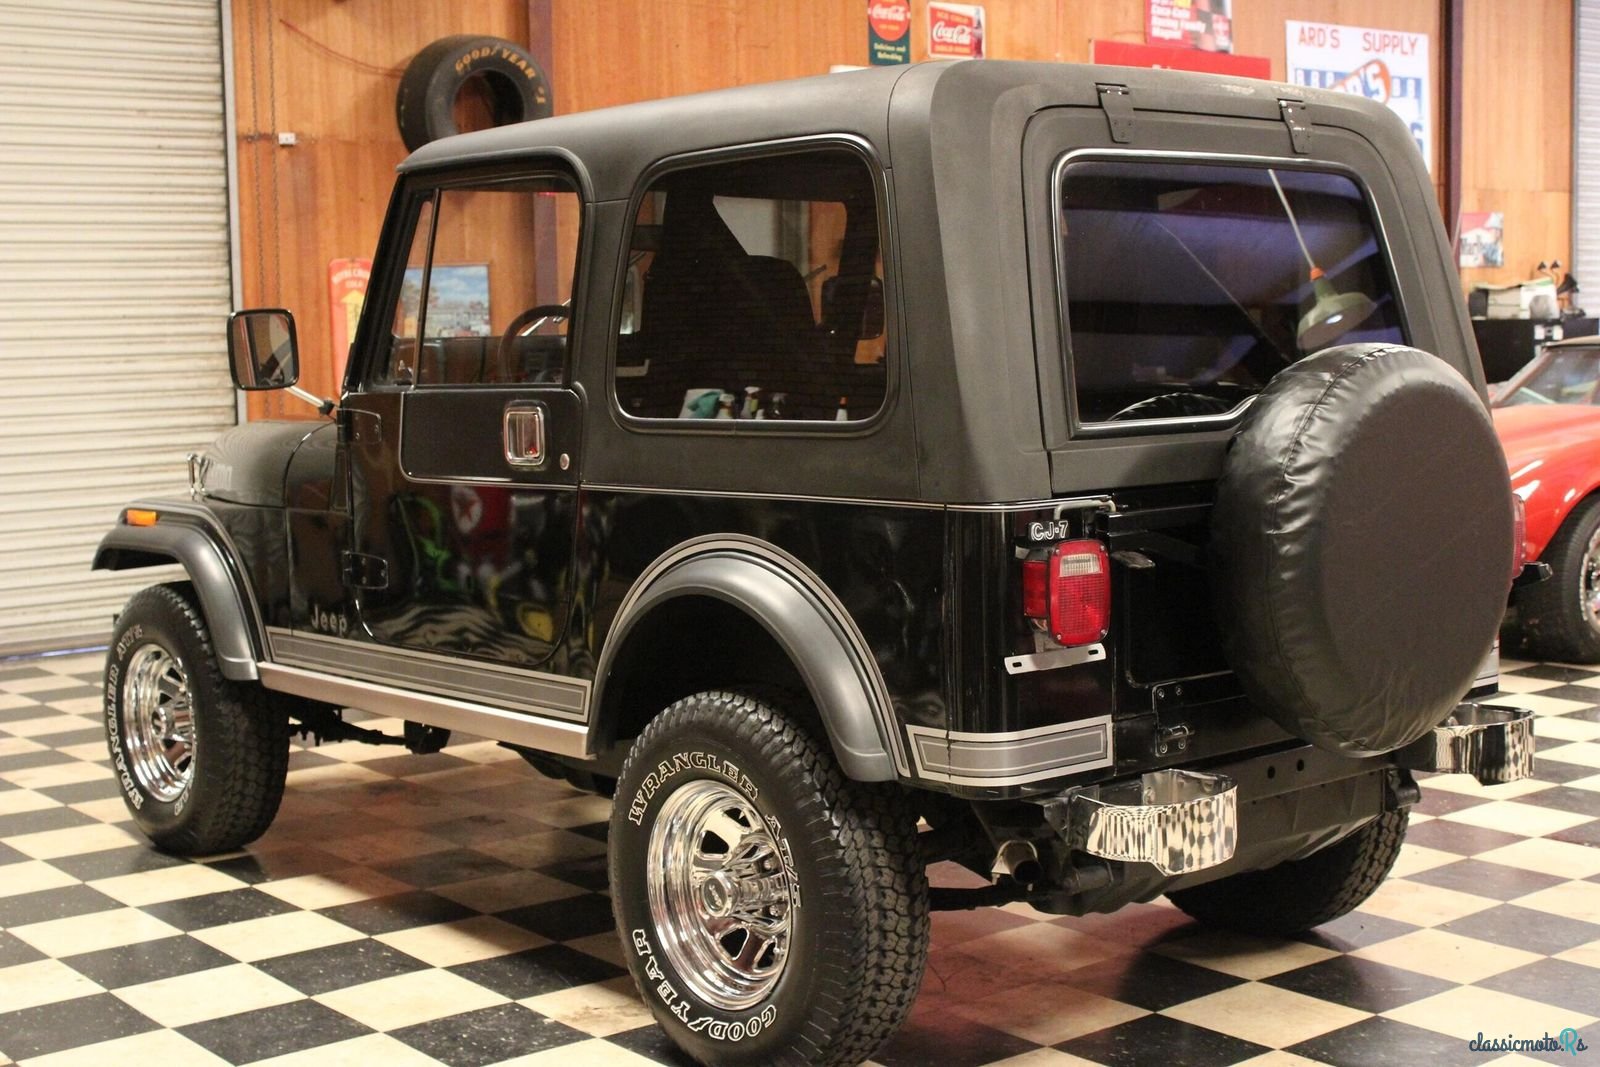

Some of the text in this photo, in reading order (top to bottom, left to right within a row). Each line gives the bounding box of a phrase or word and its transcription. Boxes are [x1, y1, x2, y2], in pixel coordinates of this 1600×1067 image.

[933, 21, 971, 45] Coca-Cola
[1362, 32, 1418, 55] SUPPLY
[1031, 521, 1069, 541] CJ-7
[311, 604, 348, 638] Jeep
[628, 752, 759, 826] WRANGLER
